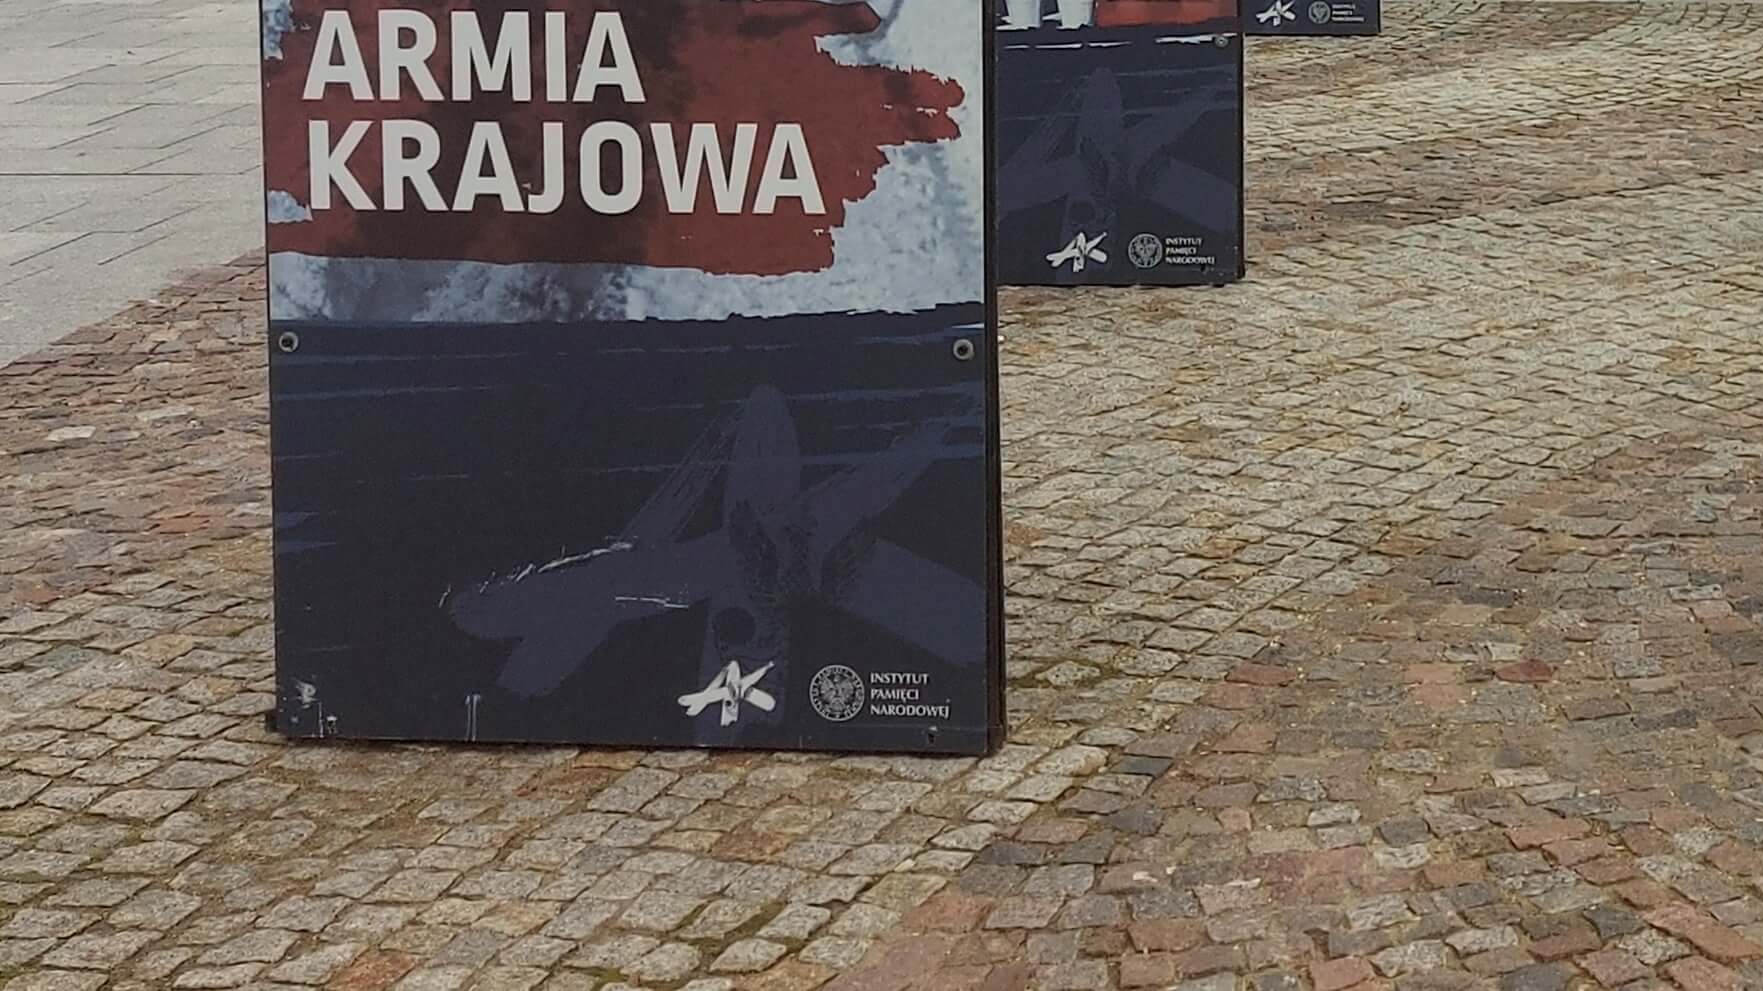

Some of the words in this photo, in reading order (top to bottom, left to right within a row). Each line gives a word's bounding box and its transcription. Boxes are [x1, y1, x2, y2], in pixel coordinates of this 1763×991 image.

[302, 9, 647, 103] ARMIA
[307, 119, 827, 214] KRAJOWA
[870, 672, 929, 685] INSTYTUT
[870, 688, 920, 701] PAMIĘCI
[870, 705, 950, 720] NARODOWEJ
